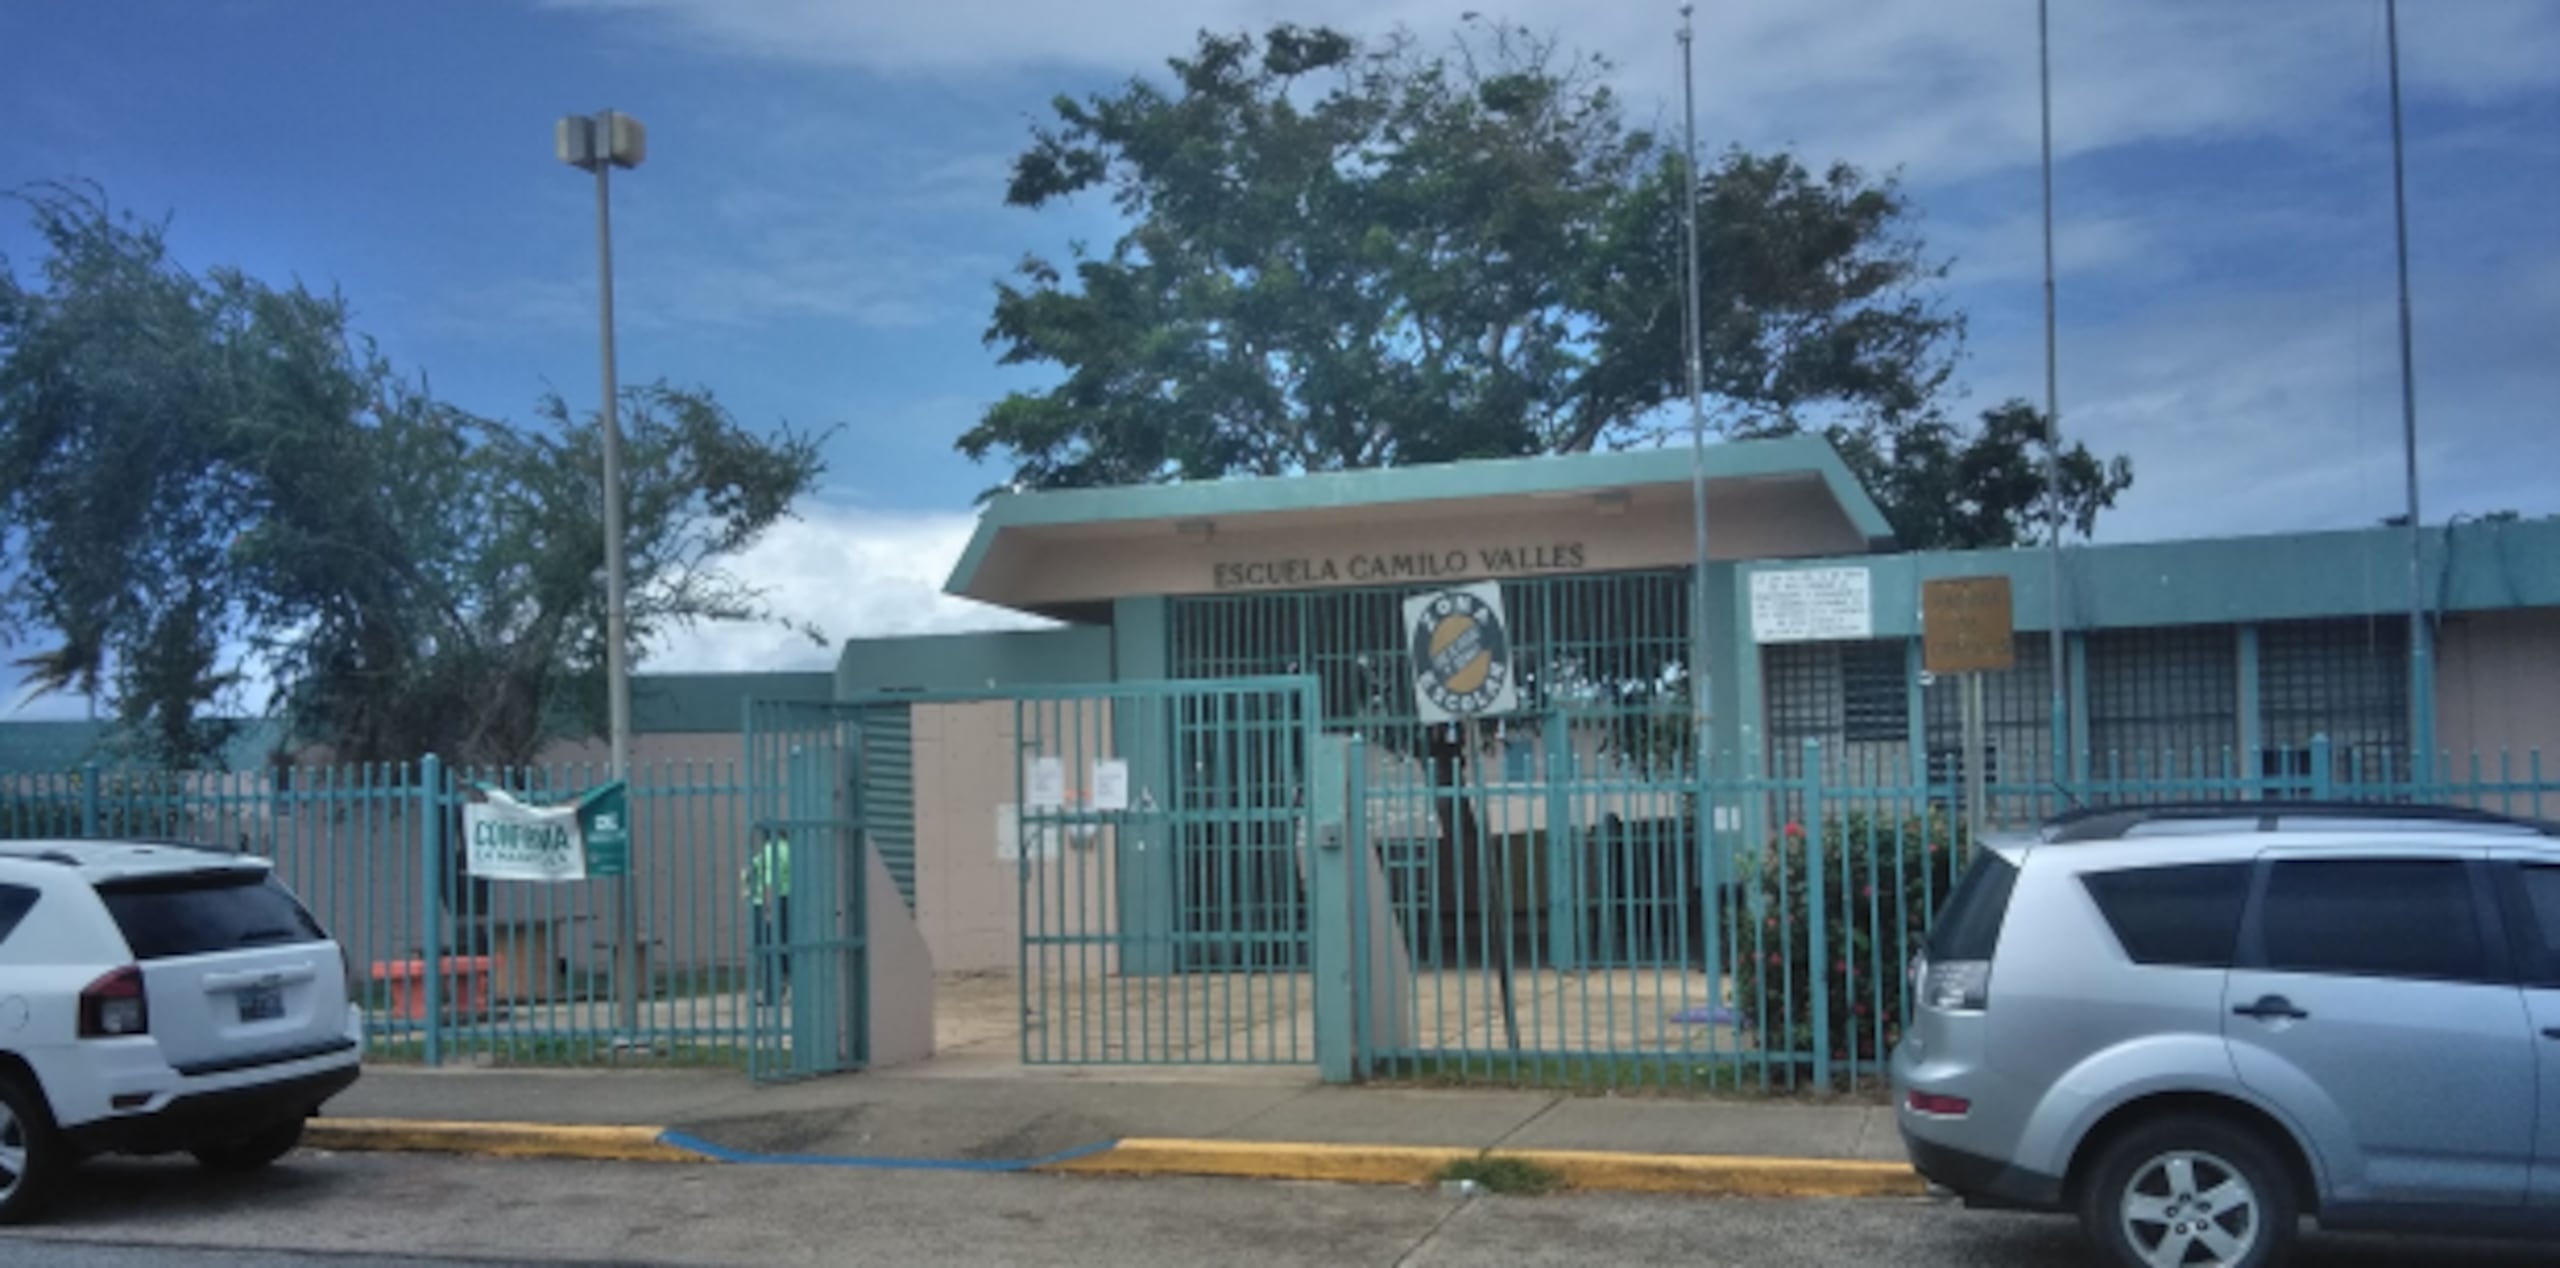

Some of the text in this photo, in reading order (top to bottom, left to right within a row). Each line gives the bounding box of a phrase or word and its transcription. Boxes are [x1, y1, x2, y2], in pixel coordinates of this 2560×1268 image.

[1213, 541, 1585, 589] ESCUELA CAMILO VALLES
[1423, 595, 1489, 632] ZONA
[1419, 661, 1505, 711] ESCOLAR
[475, 820, 572, 850] CONFIRMA
